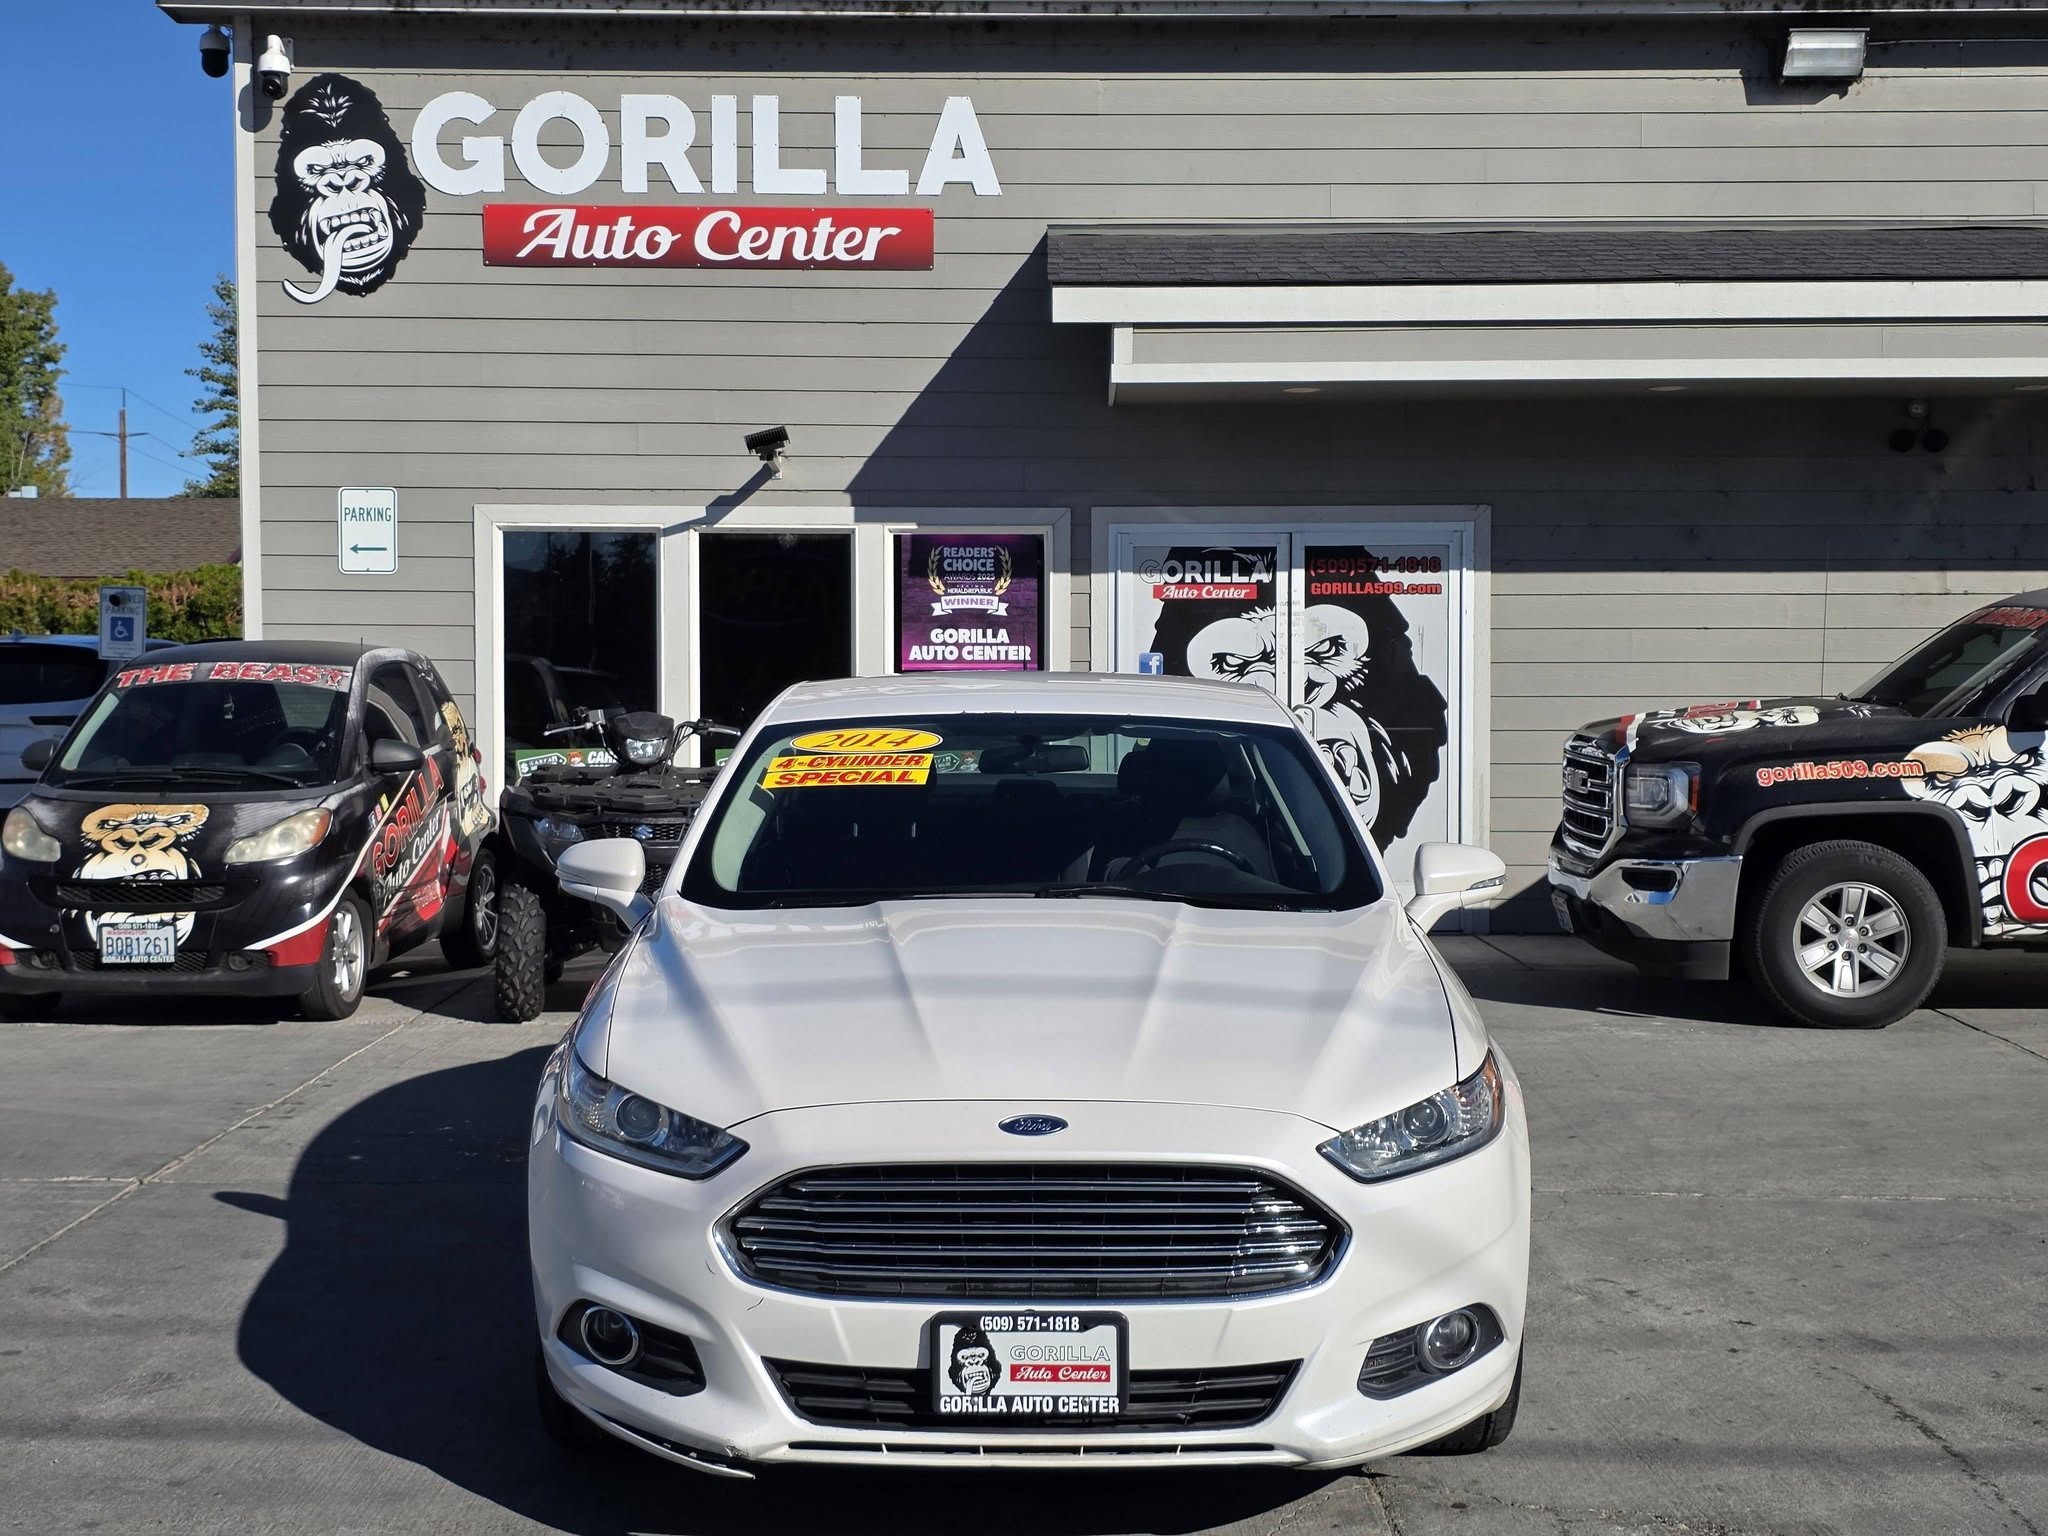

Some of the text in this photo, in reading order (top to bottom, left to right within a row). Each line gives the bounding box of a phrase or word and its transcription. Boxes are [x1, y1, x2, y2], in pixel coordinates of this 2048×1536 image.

[411, 91, 1002, 196] GORILLA
[516, 209, 902, 261] Auto Center
[344, 507, 391, 522] PARKING
[943, 547, 997, 558] READERS'
[943, 559, 995, 571] CHOICE
[1139, 559, 1273, 583] GORILLA
[1309, 557, 1442, 577] (509)571-1818
[1162, 586, 1250, 599] Auto Center
[1310, 582, 1442, 595] GORILLA509.com
[944, 598, 994, 606] WINNER
[930, 628, 1010, 643] GORILLA
[908, 645, 1031, 660] AUTO CENTER
[117, 661, 352, 688] THE BEAST
[812, 732, 920, 749] 2014
[776, 754, 927, 770] 4-CYLINDER
[774, 770, 918, 785] SPECIAL
[1757, 760, 1925, 787] gorilla509.com
[373, 755, 444, 878] GORILLA
[412, 809, 441, 865] Center
[106, 936, 169, 956] BQB1261
[980, 1316, 1080, 1331] (509) 571-1818
[1010, 1345, 1111, 1361] GORILLA
[1015, 1366, 1108, 1380] Auto Center
[940, 1396, 1120, 1413] GORILLA AUTO CENTER
